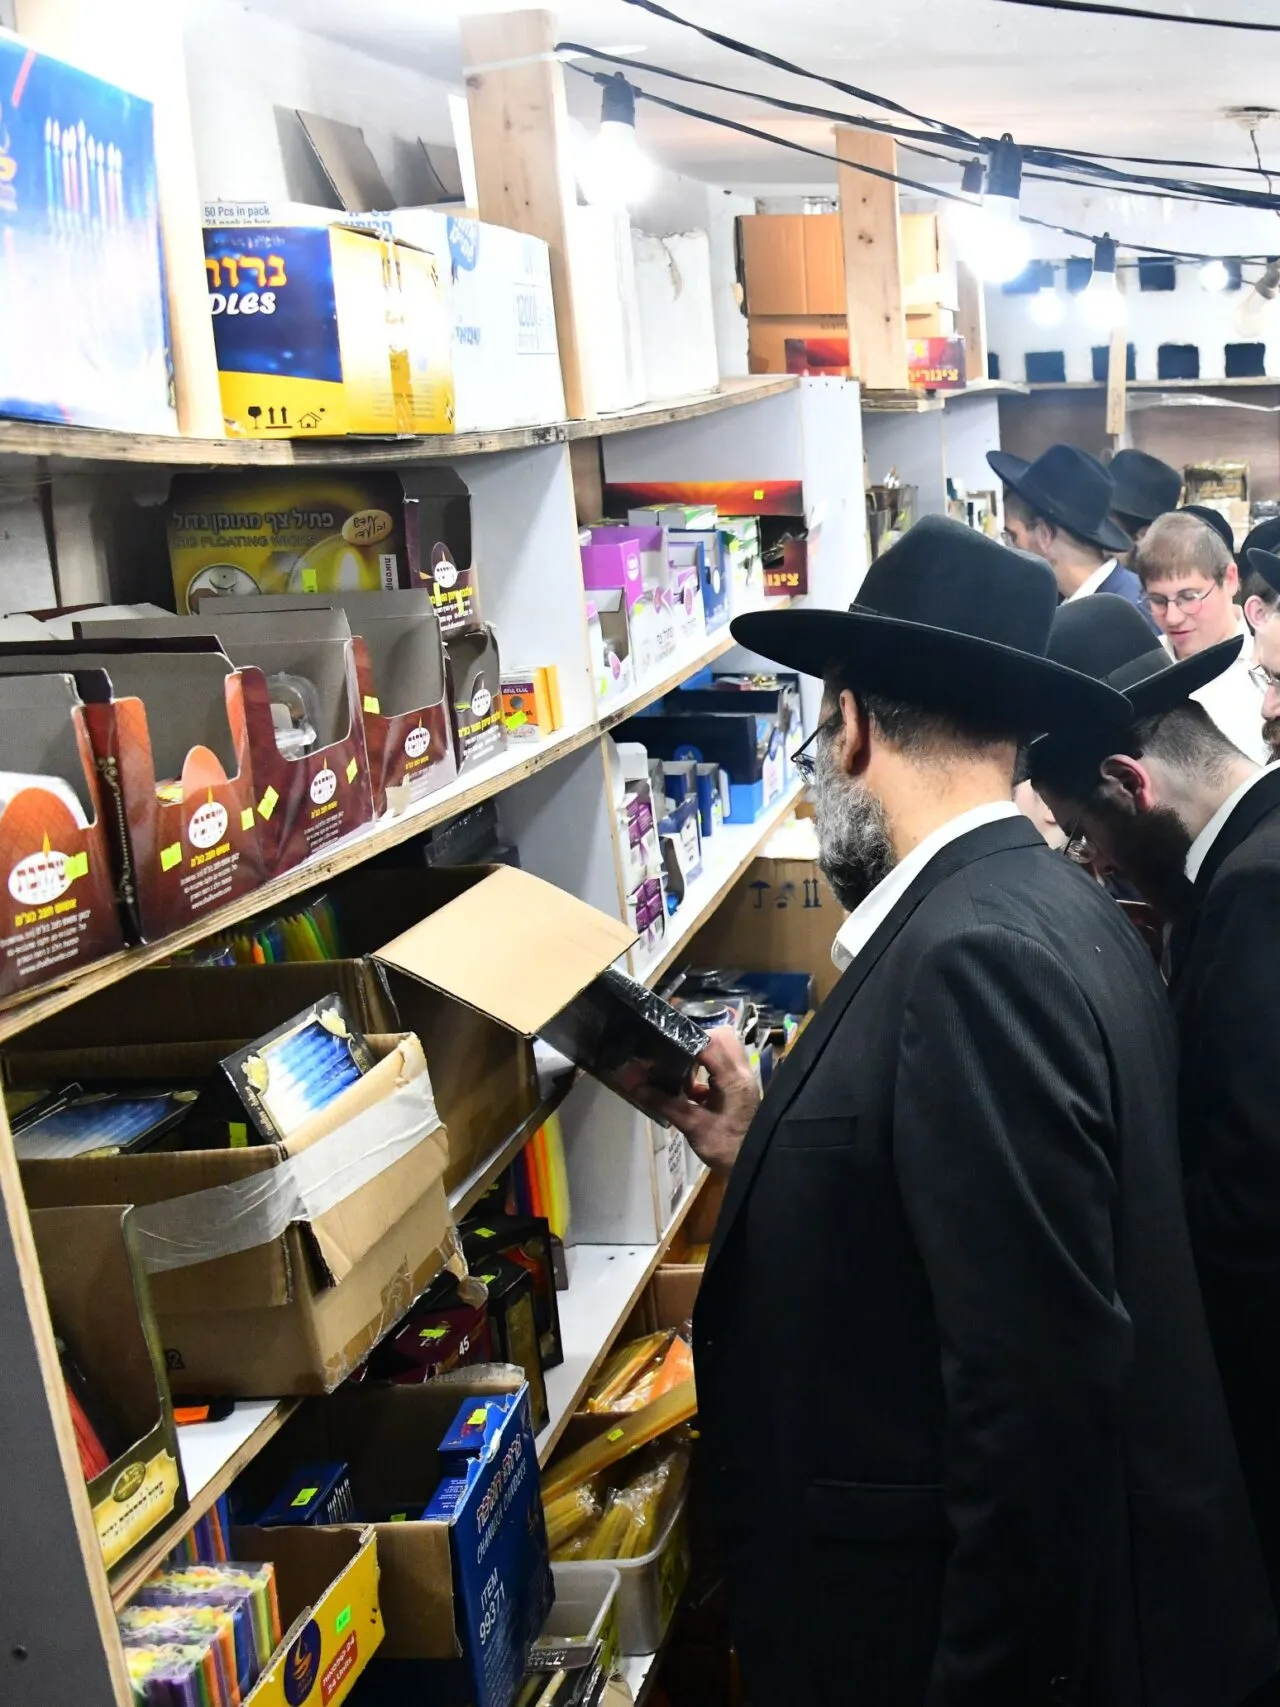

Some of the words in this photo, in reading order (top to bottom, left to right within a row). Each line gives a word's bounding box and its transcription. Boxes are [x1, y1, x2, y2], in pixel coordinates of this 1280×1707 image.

[204, 207, 216, 217] 50
[218, 206, 234, 216] Pcs
[236, 206, 245, 216] in
[247, 205, 270, 218] pack
[292, 508, 335, 530] פתיל
[459, 1334, 470, 1355] 45
[480, 1567, 499, 1611] ITEM
[479, 1581, 505, 1645] 99371
